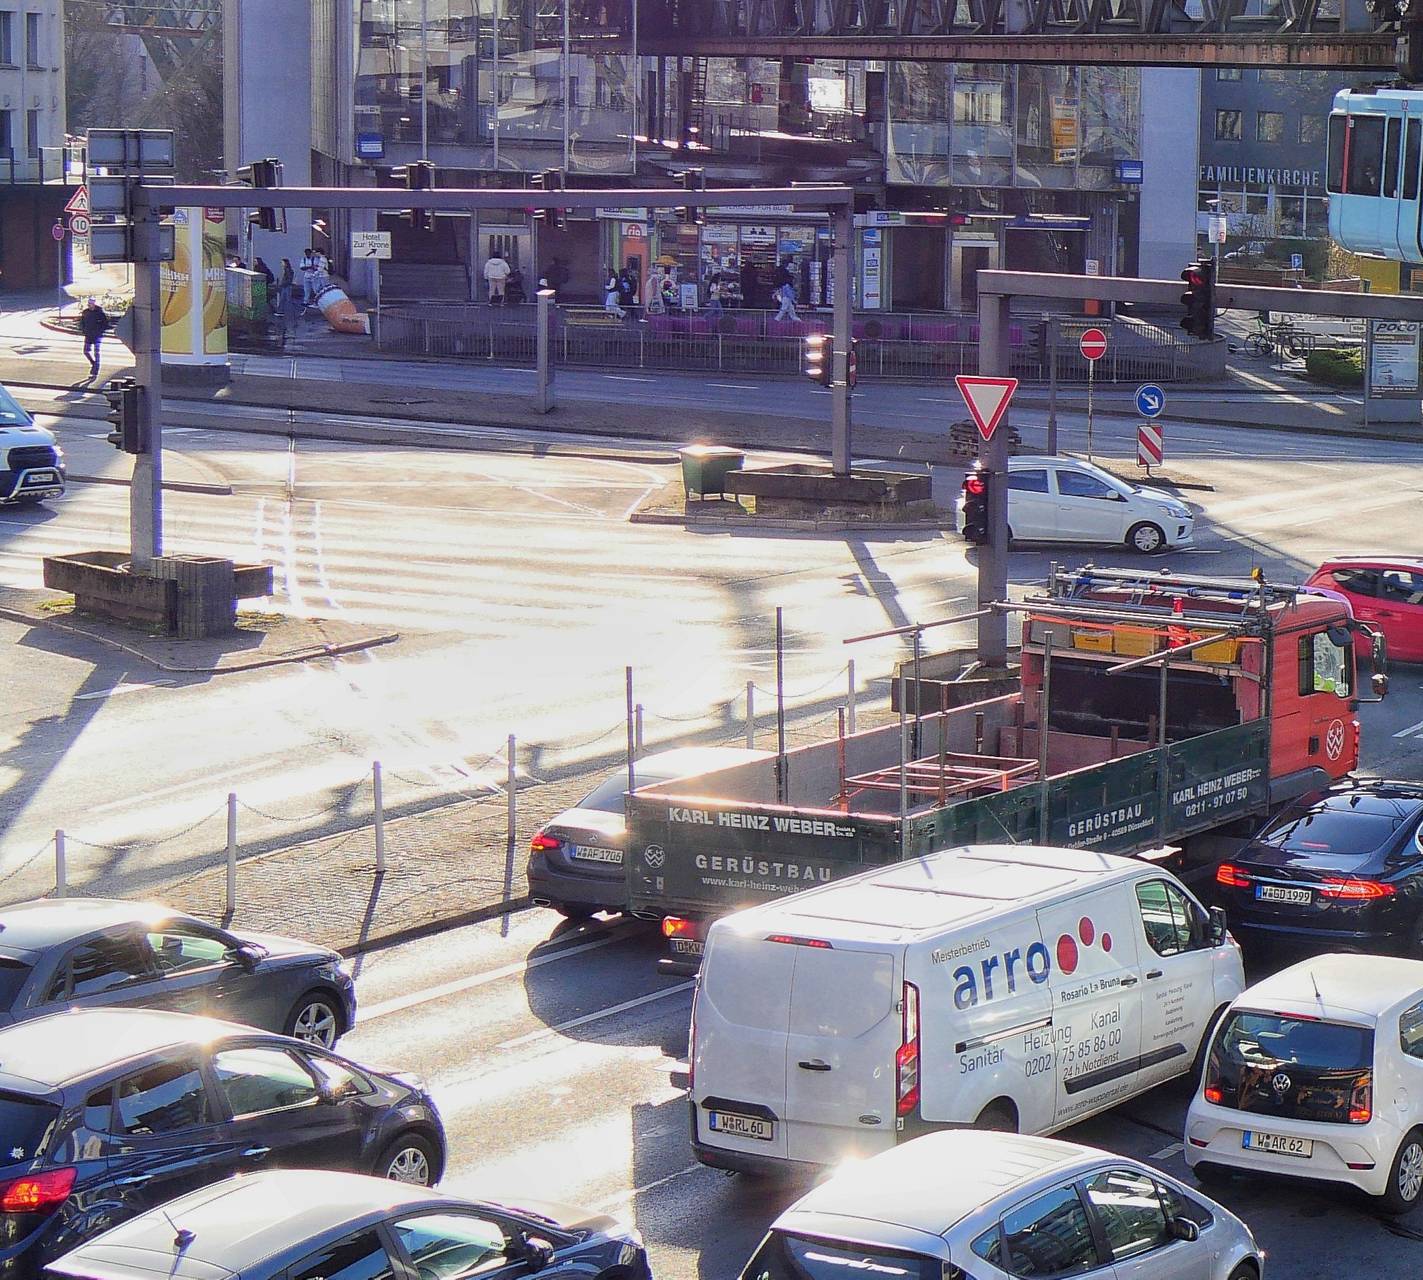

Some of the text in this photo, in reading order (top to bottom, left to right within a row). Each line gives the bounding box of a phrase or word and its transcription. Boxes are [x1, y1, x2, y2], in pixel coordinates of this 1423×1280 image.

[1199, 165, 1320, 186] FAMILIENKIRCHE
[75, 220, 87, 229] 10
[362, 233, 380, 241] Hotel
[368, 241, 389, 249] Krone
[1376, 323, 1418, 332] POCO
[1173, 787, 1195, 805] KARL
[1197, 777, 1222, 797] HEINZ
[1224, 769, 1253, 788] WEBER
[1186, 800, 1206, 818] 0211
[1213, 794, 1224, 809] 97
[1225, 791, 1236, 804] 07
[1237, 787, 1248, 801] 50
[669, 807, 836, 837] KARL HEINZ WEBER
[1069, 804, 1141, 837] GERÜSTBAU
[695, 854, 832, 882] GERÜSTBAU
[931, 937, 991, 965] Meisterbetrieb
[952, 941, 1051, 1010] arro
[1061, 977, 1121, 1002] Rosario La Bruna
[960, 1045, 1005, 1074] Sanitär
[1024, 1025, 1072, 1053] Heizung
[1091, 1003, 1121, 1031] Kanal
[1025, 1054, 1051, 1078] 0202
[1062, 1045, 1075, 1065] 75
[1078, 1040, 1091, 1059] 85
[1093, 1034, 1106, 1053] 86
[1108, 1028, 1122, 1047] 00
[1063, 1067, 1073, 1080] 24
[1081, 1051, 1120, 1072] Notdienst
